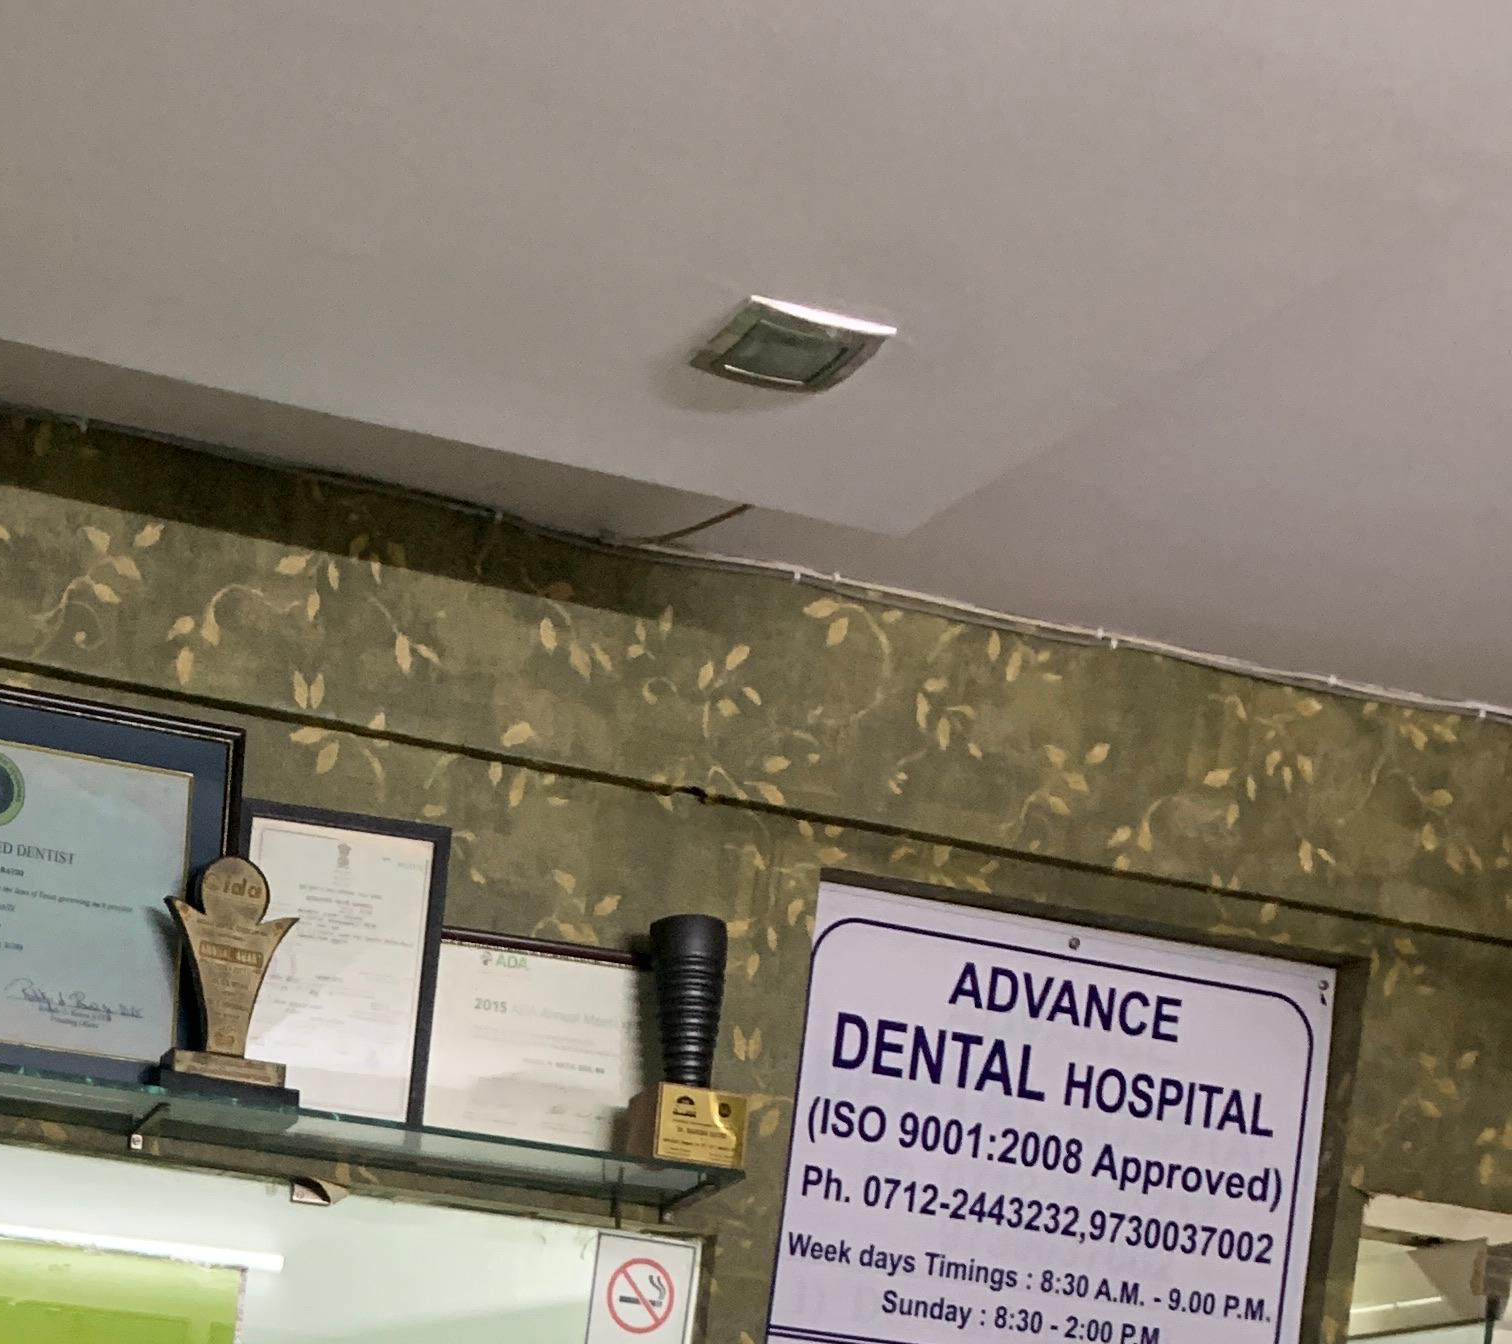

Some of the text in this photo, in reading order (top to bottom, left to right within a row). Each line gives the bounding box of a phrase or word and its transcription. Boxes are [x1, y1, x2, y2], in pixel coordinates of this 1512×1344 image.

[17, 844, 75, 865] DENTIST
[495, 955, 528, 970] ADA
[948, 961, 1182, 1043] ADVANCE
[474, 998, 508, 1014] 2015
[832, 1011, 1274, 1137] DENTAL HOSPITAL
[808, 1096, 887, 1143] (ISO
[898, 1111, 1083, 1174] 9001:2008
[1091, 1143, 1281, 1213] Approved)
[802, 1164, 1274, 1264] Ph. 0712-2443232,9730037002
[789, 1231, 851, 1264] Week
[859, 1244, 916, 1277] days
[924, 1251, 1018, 1292] Timings
[1040, 1269, 1089, 1298] 8:30
[1094, 1278, 1144, 1306] A.M.
[1168, 1287, 1215, 1315] 9.00
[1223, 1295, 1271, 1323] P.M.
[881, 1290, 972, 1329] Sunday
[994, 1305, 1043, 1334] 8:30
[1064, 1315, 1113, 1343] 2:00
